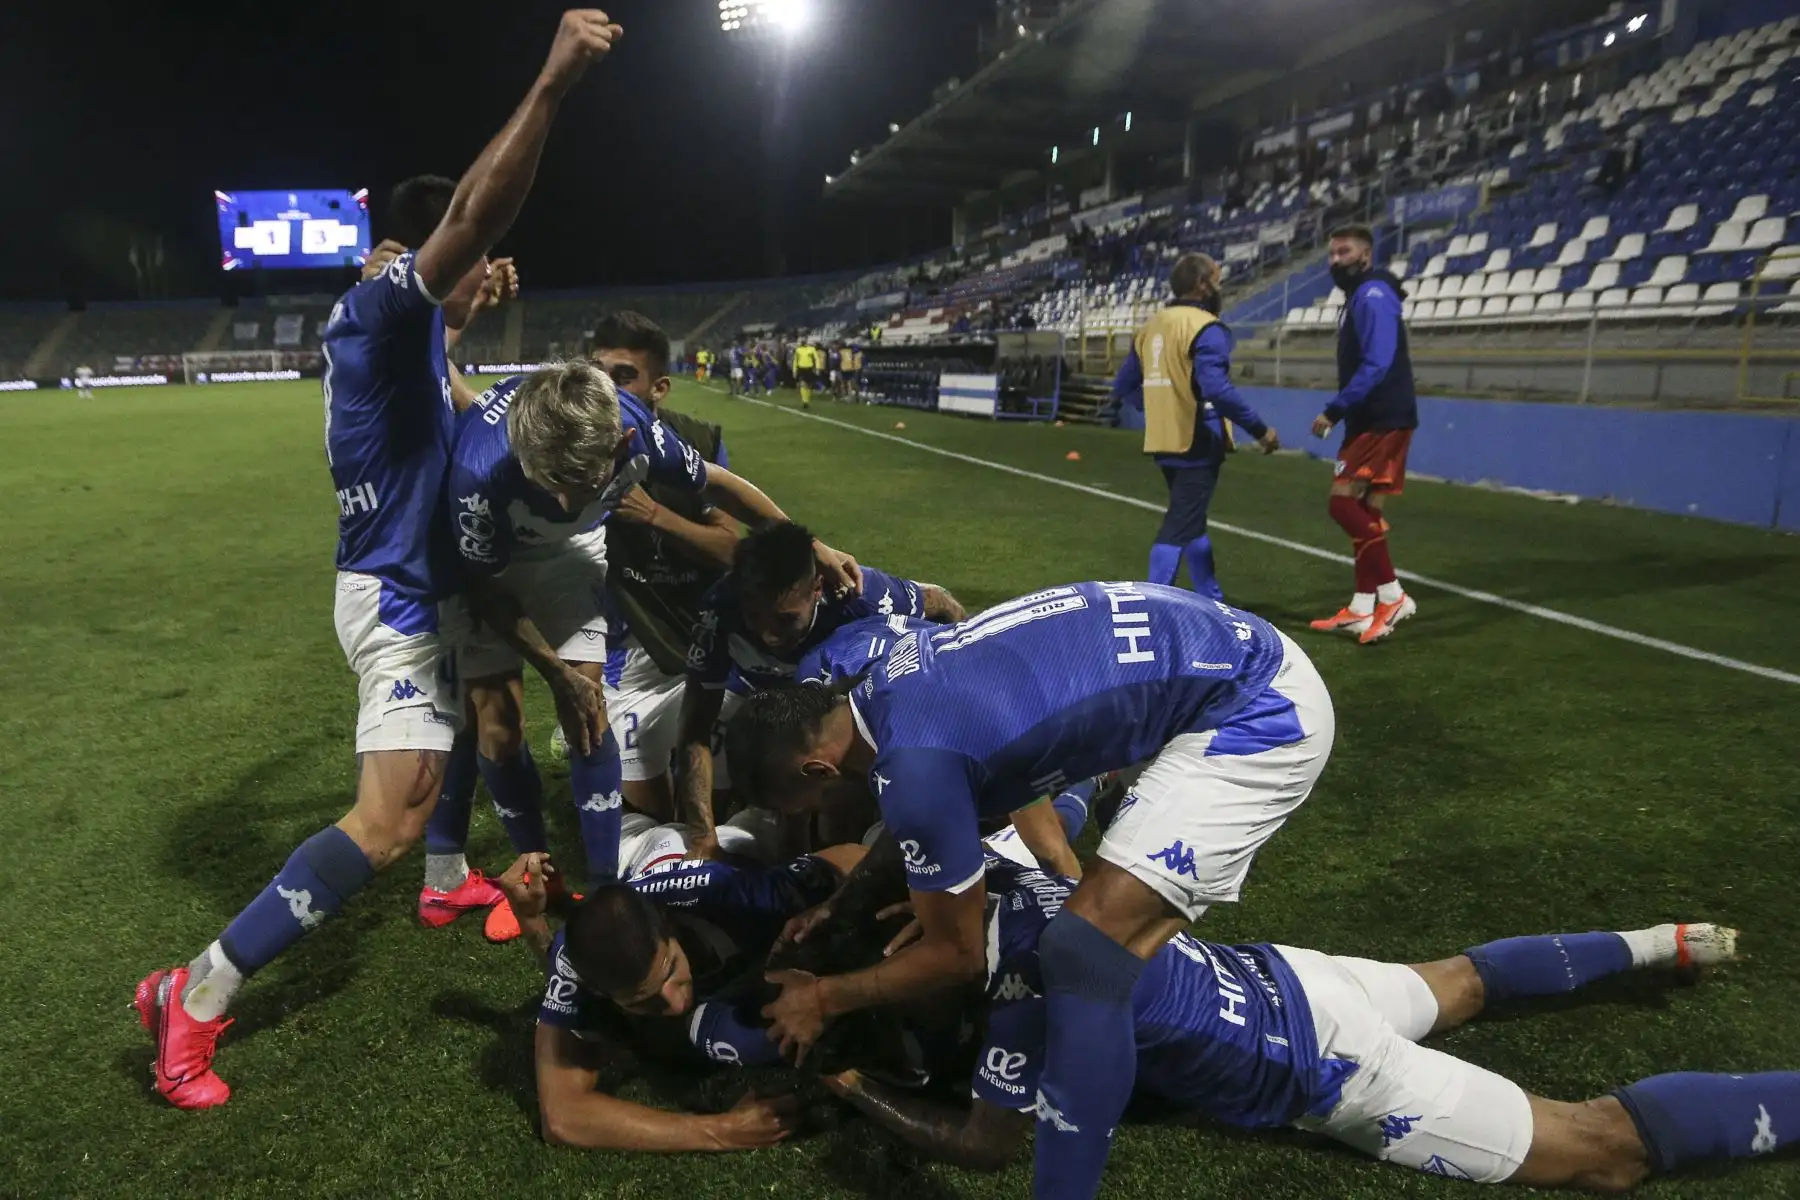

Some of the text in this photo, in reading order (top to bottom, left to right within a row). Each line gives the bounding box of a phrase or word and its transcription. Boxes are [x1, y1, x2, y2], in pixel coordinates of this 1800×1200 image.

[267, 230, 276, 245] 1
[314, 230, 327, 245] 3
[1031, 602, 1065, 615] RUS
[624, 712, 639, 750] 2
[978, 1065, 1027, 1095] AirEuropa
